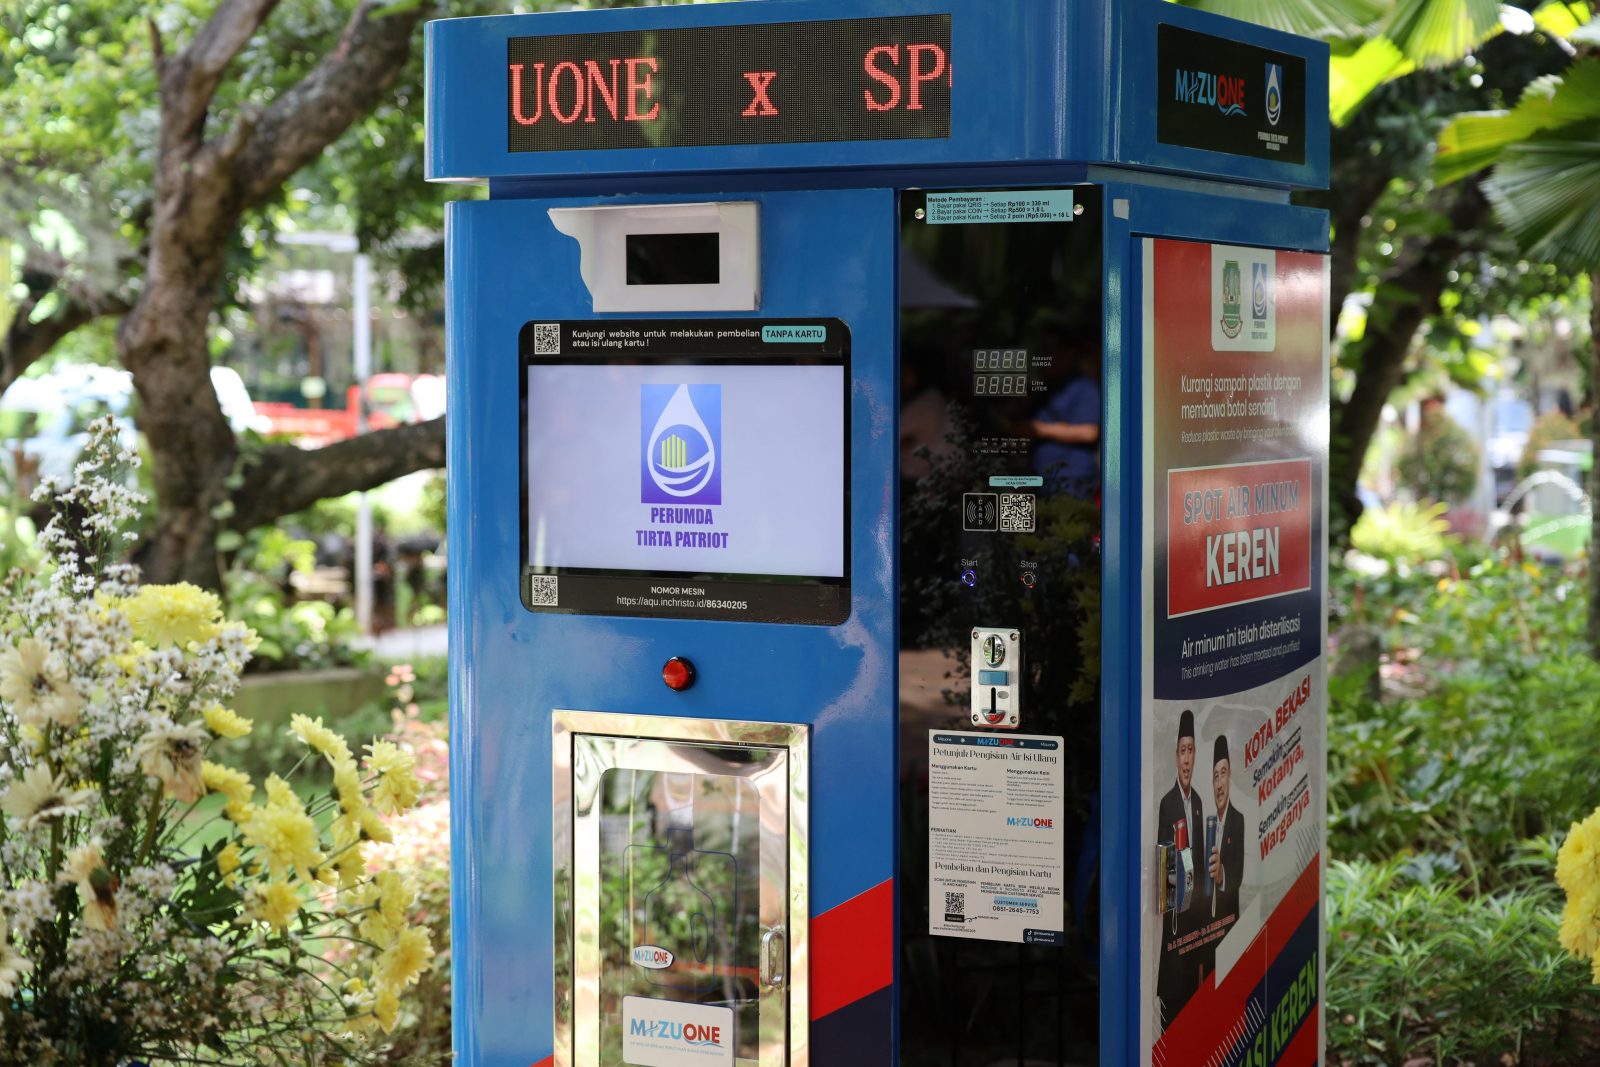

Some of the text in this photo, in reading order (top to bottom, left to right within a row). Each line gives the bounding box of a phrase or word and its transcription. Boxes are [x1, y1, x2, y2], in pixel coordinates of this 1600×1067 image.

[510, 58, 660, 125] UONE
[864, 43, 952, 110] SP
[1176, 68, 1245, 109] MIZUONE
[572, 329, 823, 339] Kunjungi website untuk melakukan pembelian TANPA KARTU
[591, 339, 599, 347] isi
[602, 339, 622, 349] ulang
[624, 339, 644, 347] kartu
[1182, 374, 1301, 398] Kurangi sampah plastik dengan
[1182, 401, 1225, 419] membawa
[1228, 399, 1247, 417] botol
[1182, 429, 1201, 444] Reduce
[1202, 428, 1219, 445] plastic
[1220, 428, 1235, 441] waste
[1184, 480, 1299, 525] SPOT AIR MINUM
[651, 507, 713, 524] PERUMDA
[636, 530, 728, 548] TIRTA PATRIOT
[961, 558, 978, 566] Start
[1020, 560, 1037, 569] Stop
[1207, 526, 1280, 588] KEREN
[651, 586, 705, 596] NOMOR MESIN
[1182, 637, 1193, 659] Air
[1196, 633, 1225, 656] minum
[1227, 628, 1236, 647] ini
[1238, 623, 1258, 645] telah
[1182, 666, 1192, 680] This
[1193, 661, 1214, 678] drinking
[1214, 658, 1229, 670] water
[1230, 655, 1239, 668] has
[1239, 653, 1253, 666] been
[1245, 718, 1273, 768] KOTA
[1276, 674, 1310, 734] BEKASI
[933, 748, 968, 758] Petunjuk
[970, 750, 1008, 760] Pengisian
[1010, 752, 1021, 760] Air
[1033, 754, 1057, 764] Ulang
[1253, 741, 1283, 787] Semakin
[1007, 817, 1053, 828] MIZUONE
[1258, 794, 1287, 839] Semakin
[1260, 790, 1310, 862] Warganya
[935, 862, 1051, 878] Pembelian dan Pengisian Kartu
[634, 949, 668, 963] MIZUONE
[1272, 952, 1316, 1061] KEREN
[630, 1018, 720, 1044] MIZUONE
